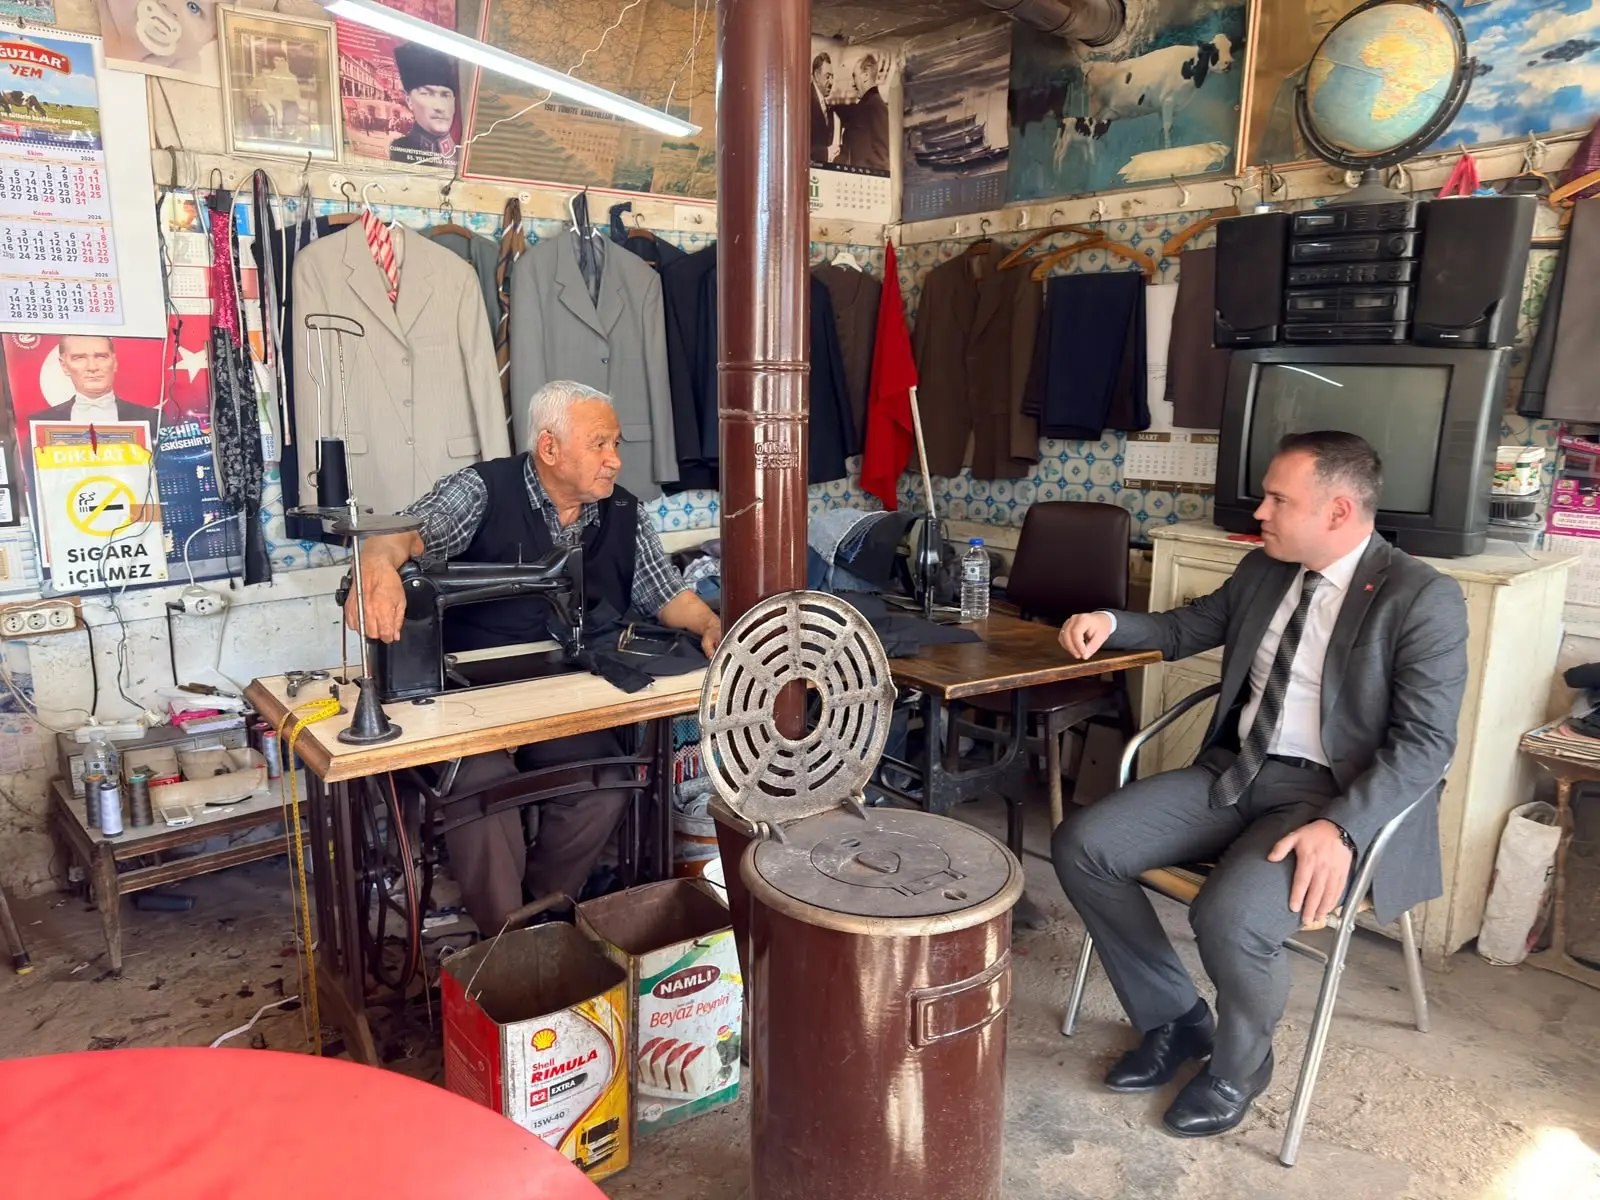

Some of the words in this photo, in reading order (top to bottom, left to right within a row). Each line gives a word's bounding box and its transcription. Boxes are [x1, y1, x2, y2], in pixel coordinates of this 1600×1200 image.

[0, 44, 62, 68] ĞUZLAR
[10, 64, 43, 79] YEM
[660, 970, 712, 995] NAMLI
[650, 1005, 693, 1028] Beyaz
[696, 993, 729, 1015] Peyniri
[531, 1049, 598, 1084] RIMULA
[532, 1058, 554, 1071] Shell
[532, 1091, 546, 1103] R2
[551, 1080, 576, 1095] EXTRA
[533, 1111, 565, 1129] 15W-40
